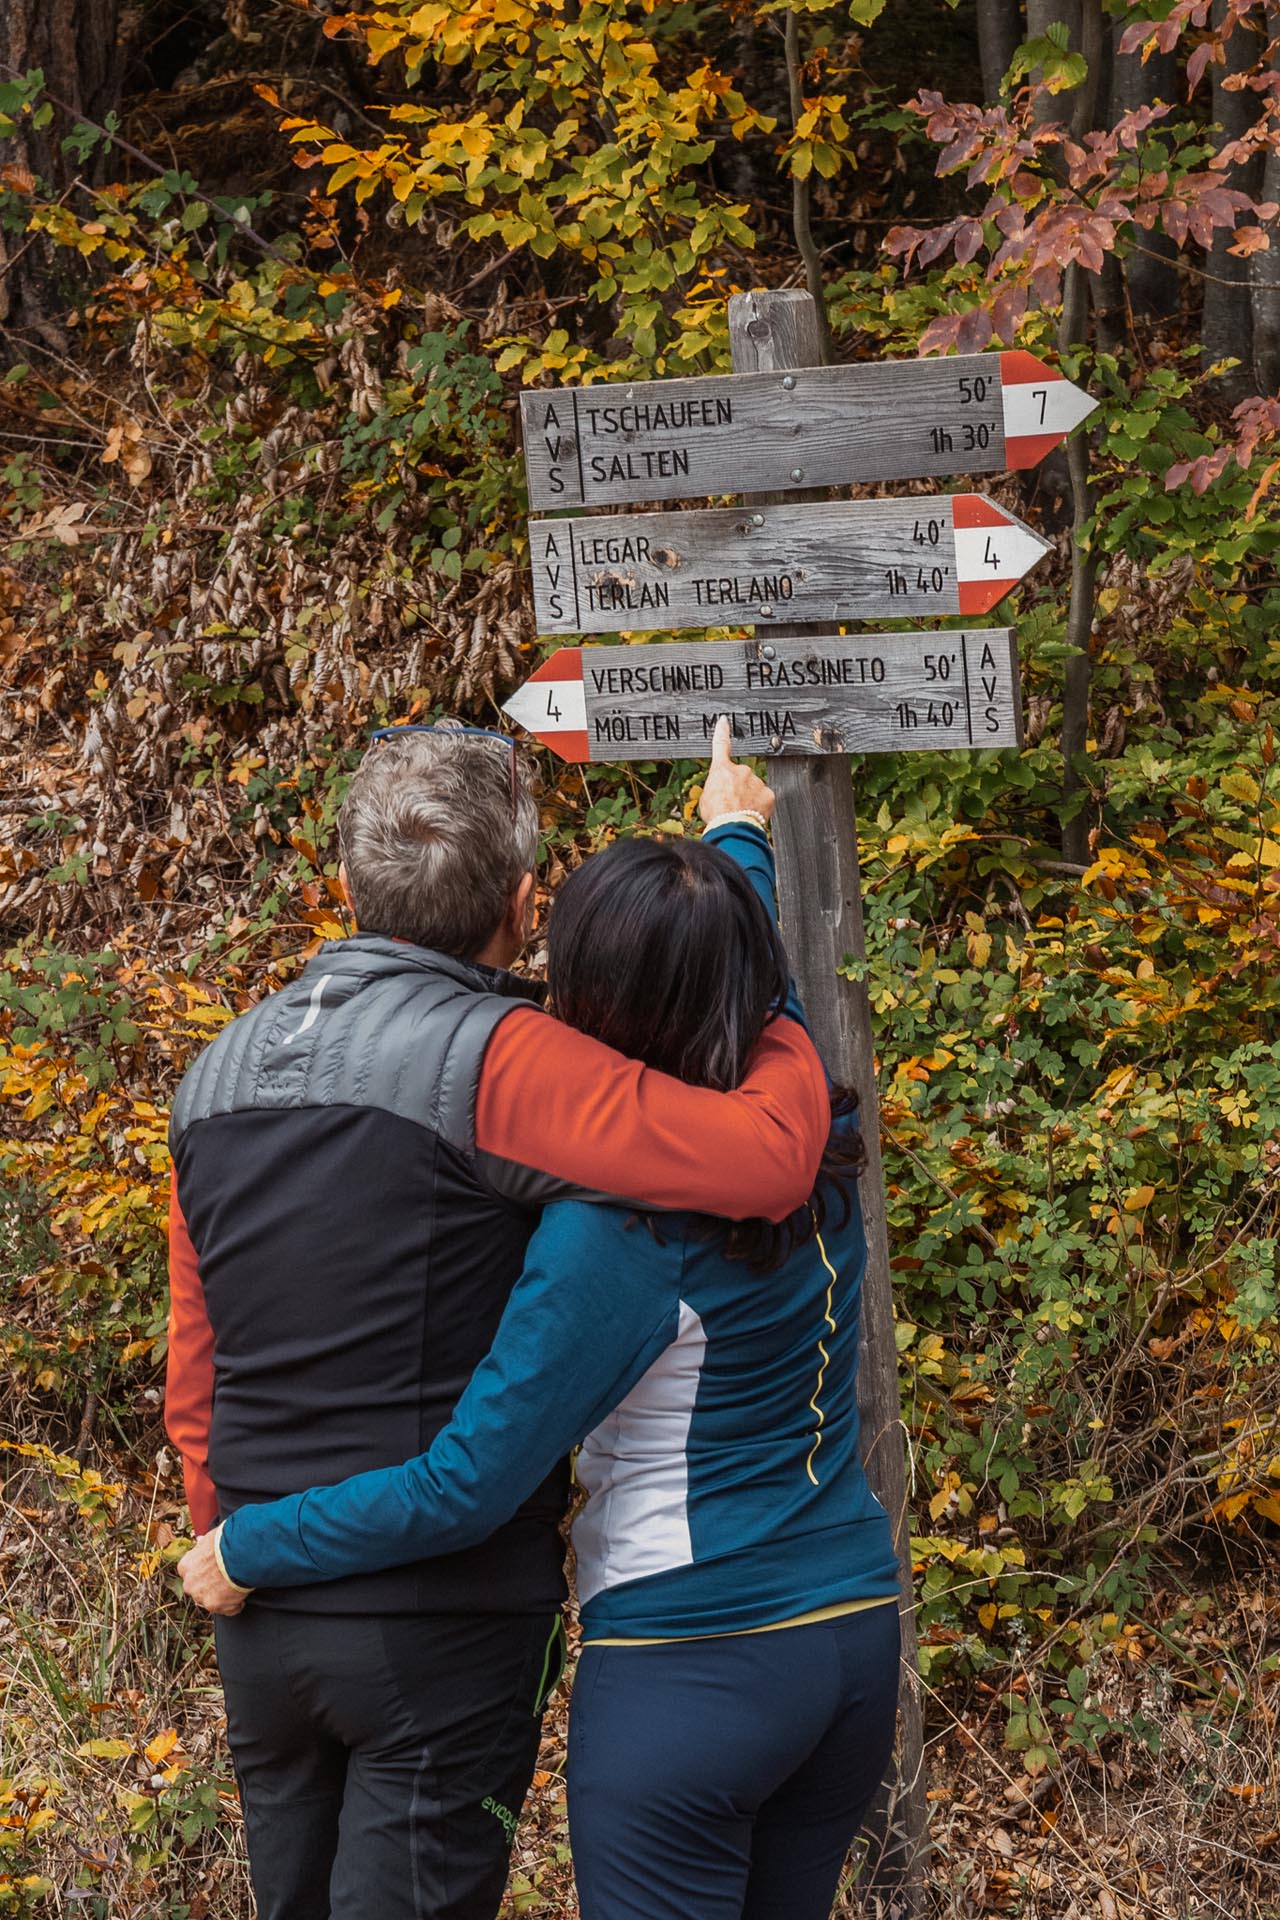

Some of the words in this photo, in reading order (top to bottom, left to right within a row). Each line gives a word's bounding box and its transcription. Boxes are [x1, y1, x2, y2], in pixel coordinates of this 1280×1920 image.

[958, 376, 993, 404] 50'
[586, 398, 733, 435] TSCHAUFEN
[1032, 390, 1047, 425] 7
[929, 427, 953, 454] 1h
[962, 422, 996, 450] 30'
[591, 449, 689, 482] SALTEN
[913, 519, 945, 546] 40'
[580, 536, 652, 566] LEGAR
[984, 536, 1001, 570] 4
[585, 582, 670, 611] TERLAN
[692, 574, 793, 605] TERLANO
[885, 569, 907, 595] 1h
[917, 566, 949, 593] 40'
[591, 663, 724, 694] VERSCHNEID
[746, 657, 885, 688] FRASSINETO
[924, 654, 956, 681] 50'
[546, 689, 562, 723] 4
[896, 702, 917, 728] 1h
[927, 701, 959, 726] 40'
[595, 710, 680, 742] MÖLTEN
[702, 711, 797, 739] MLTINA
